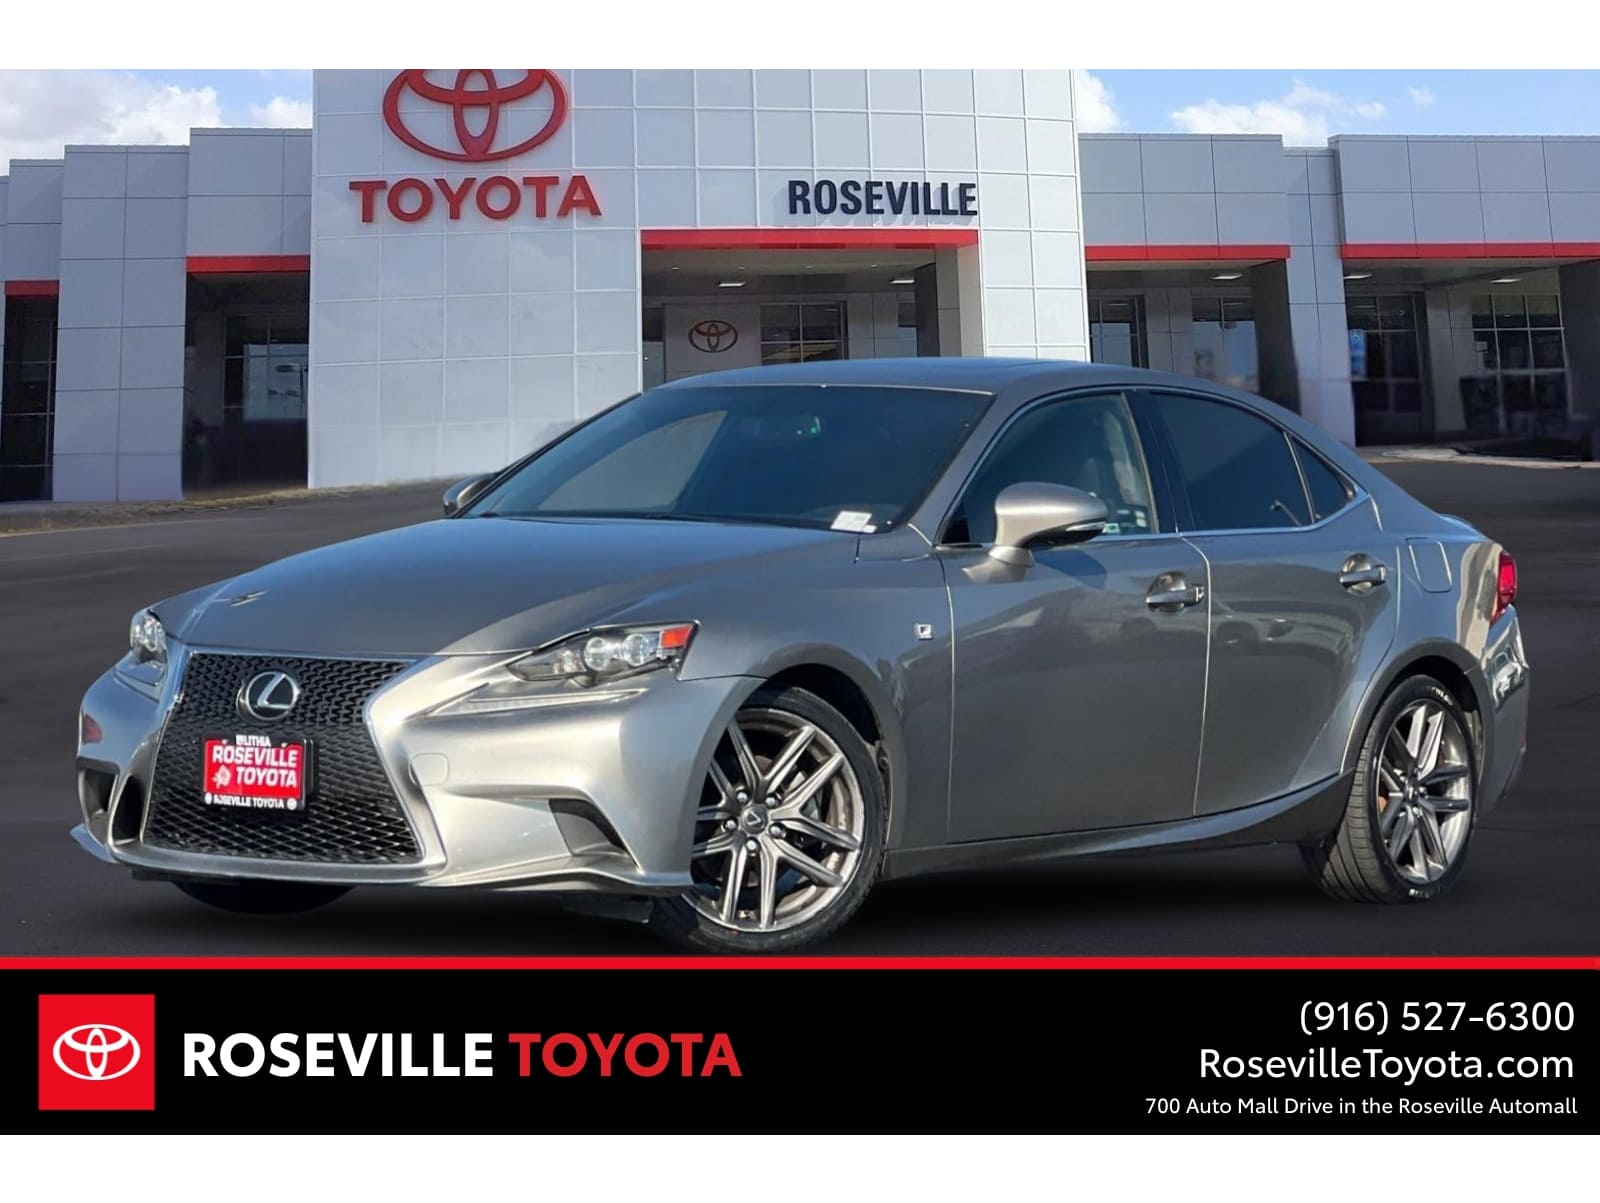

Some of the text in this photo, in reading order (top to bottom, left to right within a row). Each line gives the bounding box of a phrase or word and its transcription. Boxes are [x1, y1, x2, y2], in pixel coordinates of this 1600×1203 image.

[349, 175, 602, 223] TOYOTA
[788, 179, 978, 216] ROSEVILLE
[212, 745, 298, 767] ROSEVILLE
[236, 766, 298, 788] TOYOTA
[252, 797, 285, 809] TOYOTA
